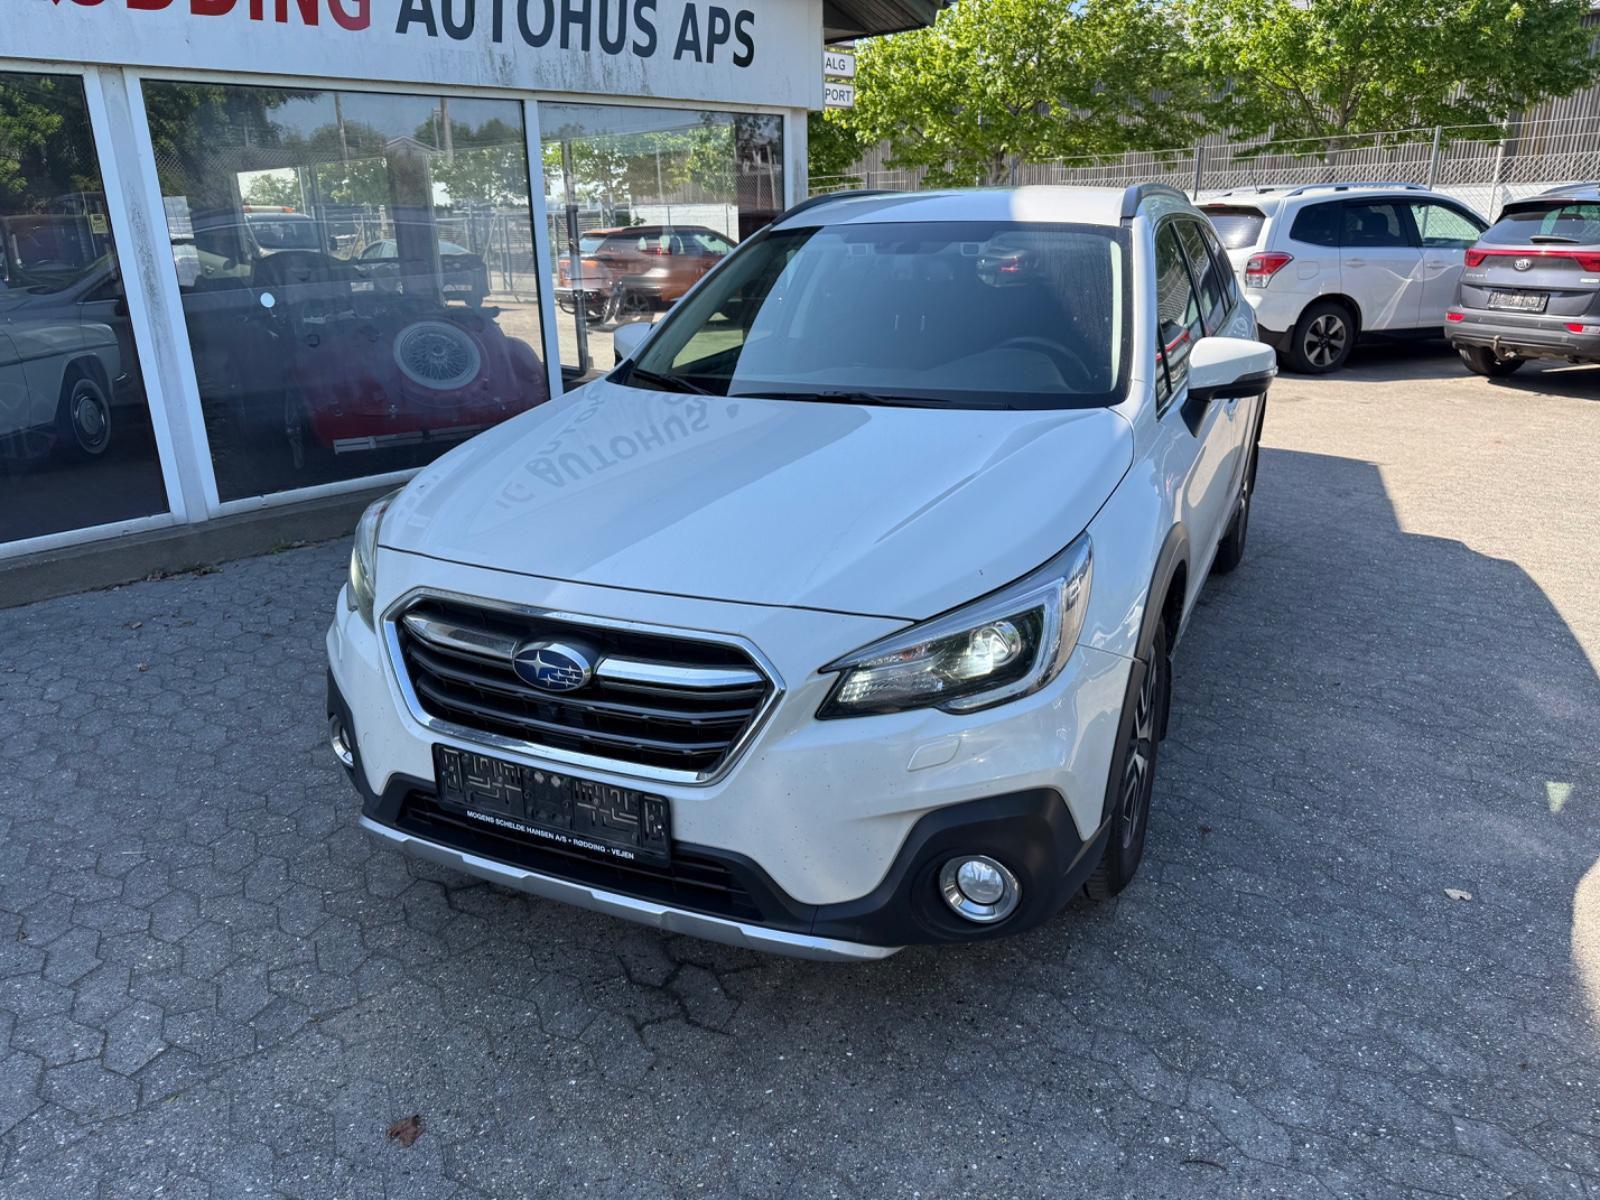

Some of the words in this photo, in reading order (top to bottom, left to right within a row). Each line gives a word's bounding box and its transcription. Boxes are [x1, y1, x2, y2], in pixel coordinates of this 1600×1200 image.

[672, 2, 755, 68] APS
[825, 57, 846, 71] ALG
[825, 88, 852, 102] PORT
[466, 810, 495, 824] MOGENS
[495, 818, 525, 832] SCHELDE
[526, 826, 554, 840] HANSEN
[611, 847, 635, 860] VEJEN
